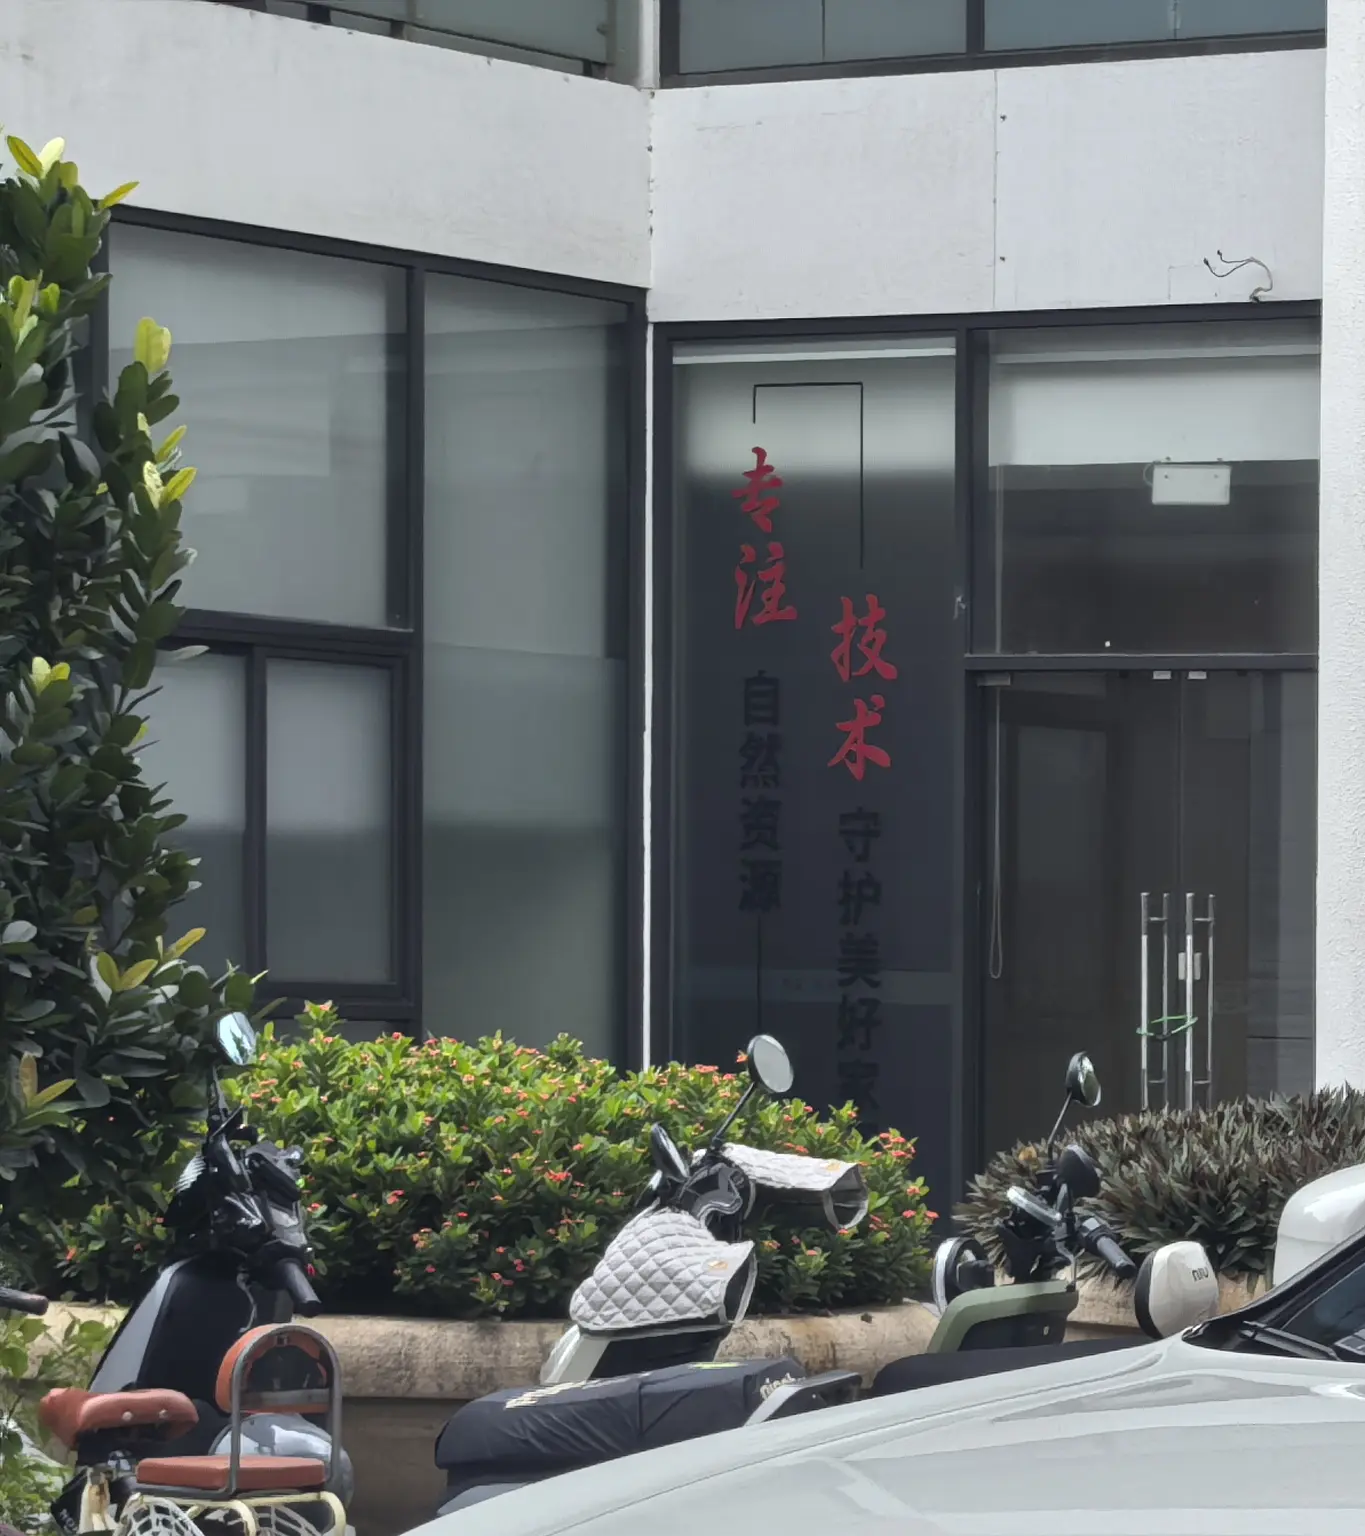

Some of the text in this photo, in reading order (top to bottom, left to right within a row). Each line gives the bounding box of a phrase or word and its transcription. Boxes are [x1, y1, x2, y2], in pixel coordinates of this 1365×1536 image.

[732, 447, 797, 629] 专注
[738, 669, 783, 915] 自然资源
[827, 594, 898, 781] 技术
[836, 806, 883, 1140] 守护美好家
